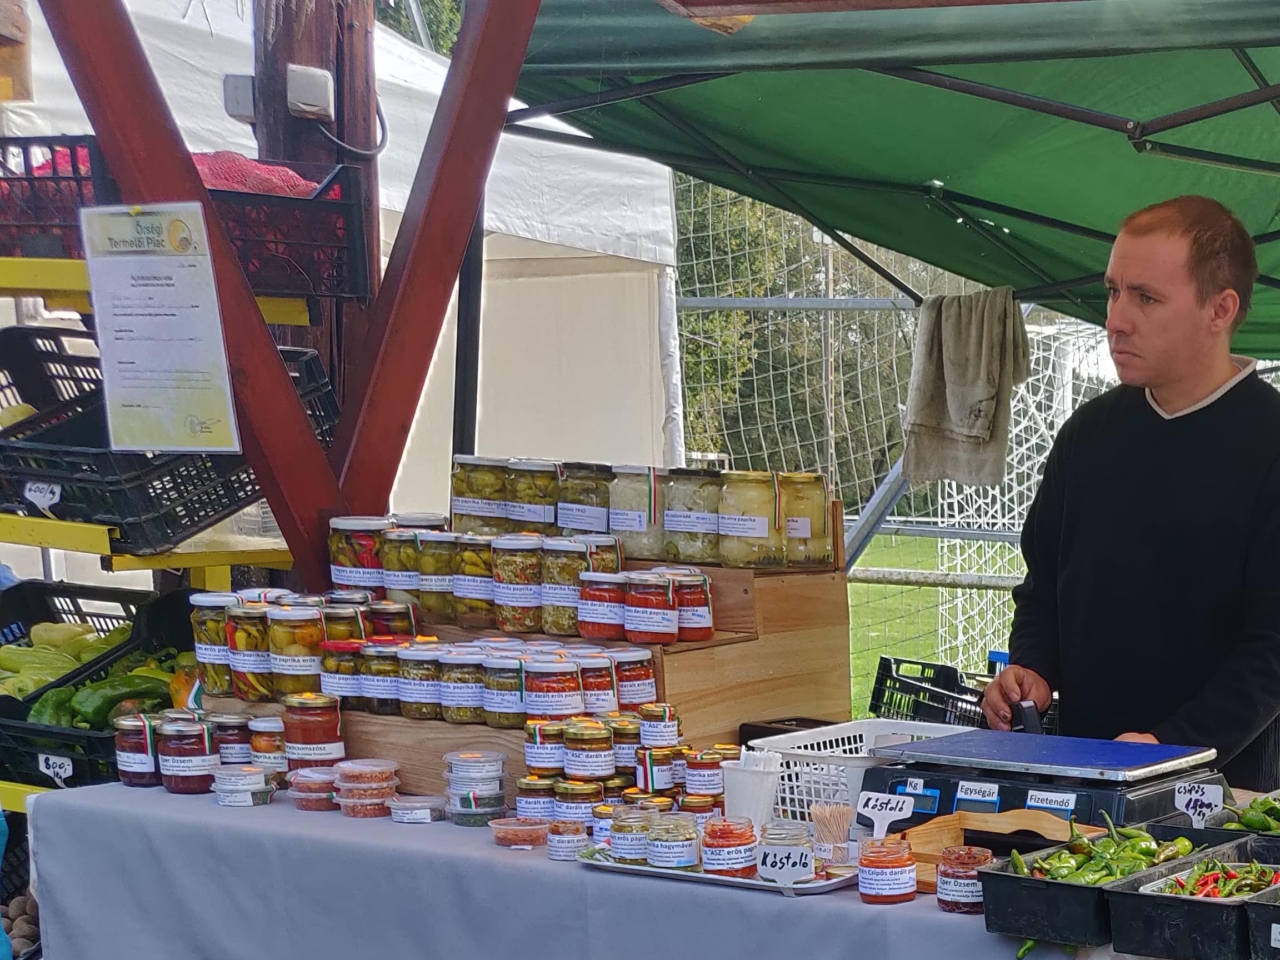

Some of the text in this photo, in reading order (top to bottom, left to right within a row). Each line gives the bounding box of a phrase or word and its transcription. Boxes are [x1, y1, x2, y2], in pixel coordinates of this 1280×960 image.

[135, 220, 164, 236] Őrségi
[108, 237, 166, 250] Termelői Piac
[649, 610, 668, 618] paprika
[909, 781, 918, 791] Kg
[960, 785, 996, 798] Egységár
[862, 797, 904, 812] Kóstoló
[1029, 794, 1070, 808] Fizetendő
[761, 851, 809, 870] Kóstoló
[954, 880, 978, 888] Dzsem
